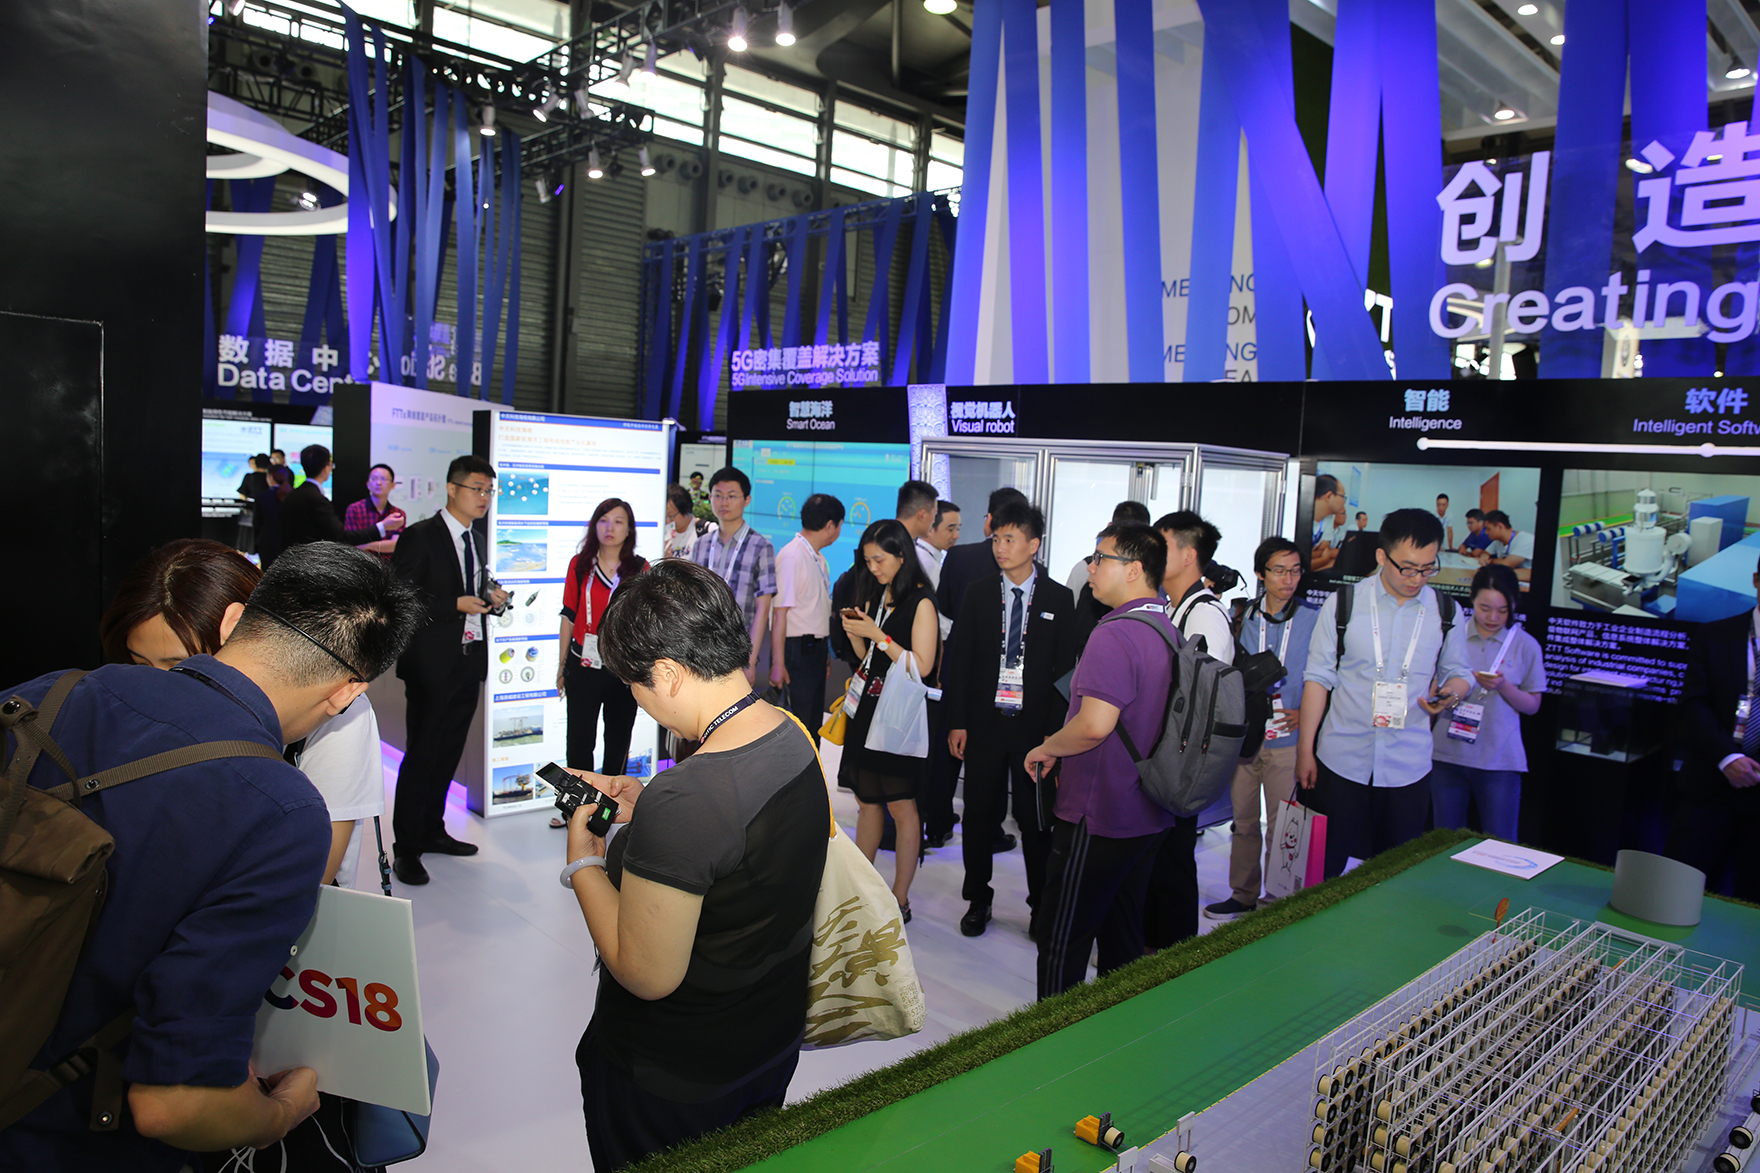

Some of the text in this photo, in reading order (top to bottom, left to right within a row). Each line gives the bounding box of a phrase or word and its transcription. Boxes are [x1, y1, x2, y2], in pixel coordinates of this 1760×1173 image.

[1436, 121, 1760, 266] 创造
[1429, 269, 1760, 343] Creating
[731, 341, 880, 372] 5G密集覆盖解决方案
[217, 363, 286, 390] Data
[787, 370, 835, 387] Coverage
[835, 367, 879, 384] Solution
[788, 400, 834, 418] 智慧海洋
[950, 400, 1017, 419] 视觉机器人
[1404, 388, 1451, 412] 智能
[1684, 387, 1749, 414] 软件
[786, 418, 836, 430] Smart Ocean
[951, 418, 1015, 434] Visual robot
[1388, 415, 1463, 432] Intelligence
[1632, 418, 1714, 437] Intelligent
[1564, 646, 1601, 658] Software
